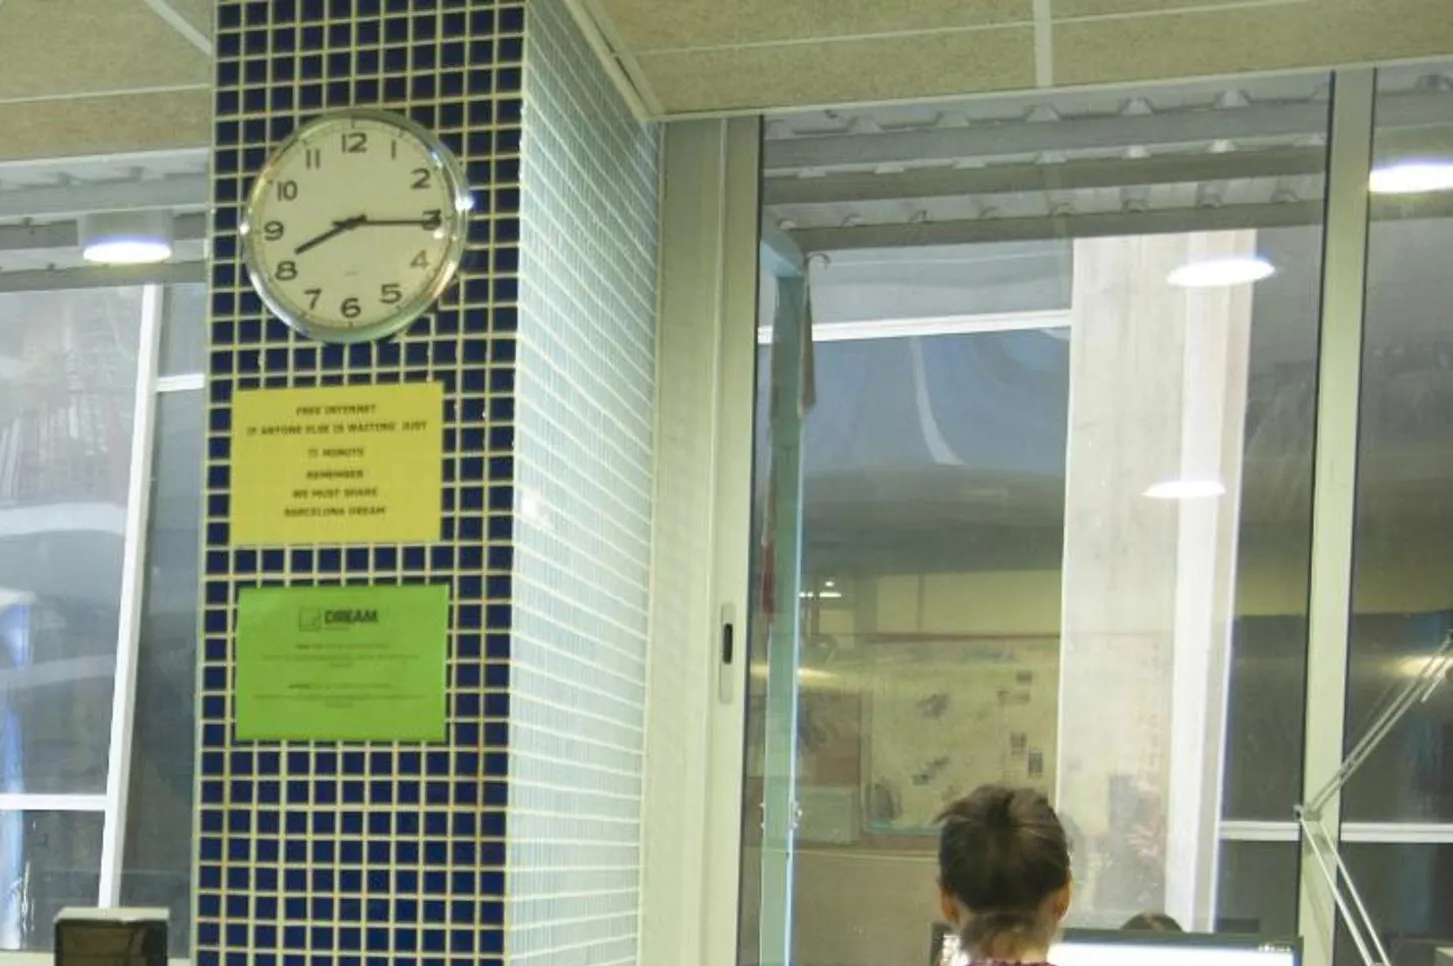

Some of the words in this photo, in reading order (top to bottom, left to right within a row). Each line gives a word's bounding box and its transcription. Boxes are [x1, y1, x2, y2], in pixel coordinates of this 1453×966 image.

[341, 133, 368, 153] 12
[391, 140, 397, 159] 1
[305, 149, 321, 169] 11
[411, 169, 431, 189] 2
[277, 181, 297, 201] 10
[264, 222, 284, 240] 9
[410, 250, 428, 270] 4
[275, 261, 298, 280] 8
[304, 289, 321, 310] 7
[380, 284, 403, 303] 5
[341, 298, 361, 317] 6
[324, 609, 377, 623] DREAM
